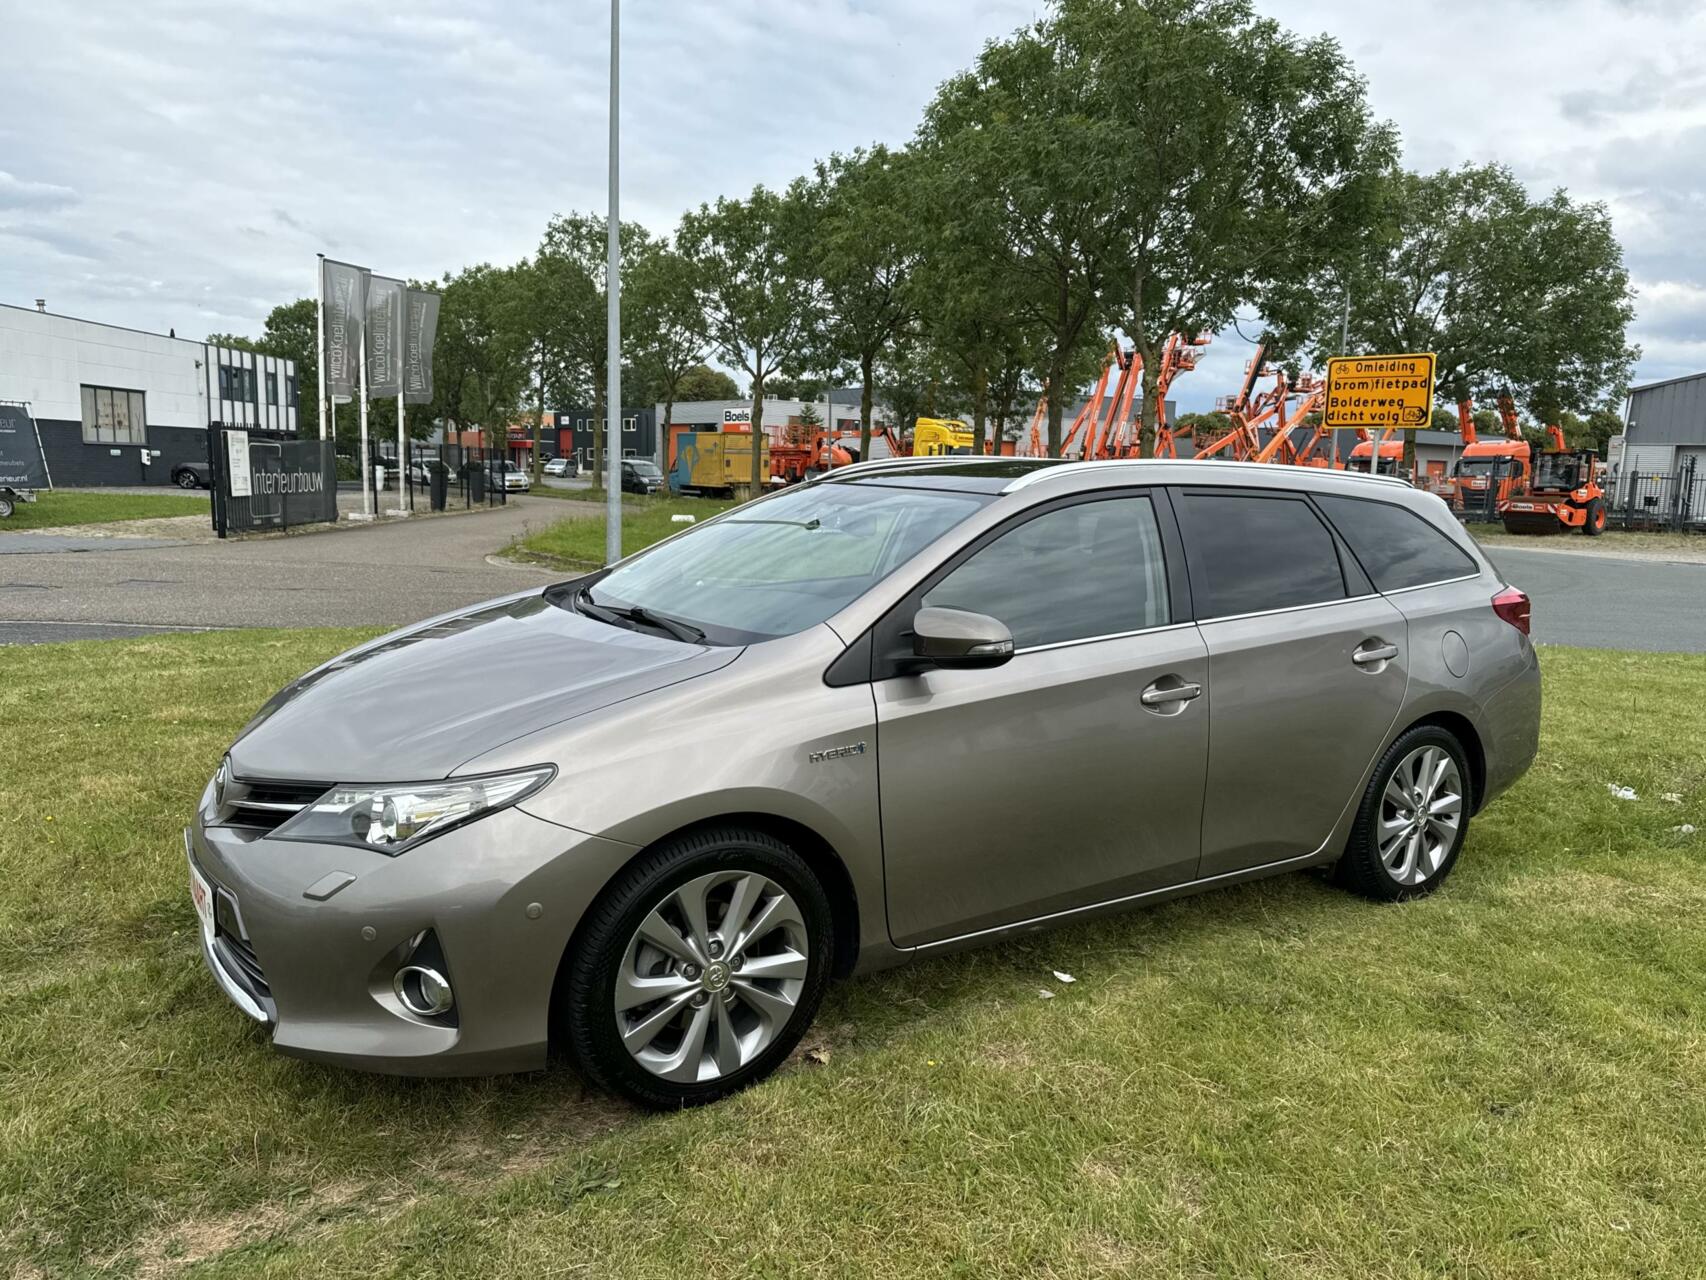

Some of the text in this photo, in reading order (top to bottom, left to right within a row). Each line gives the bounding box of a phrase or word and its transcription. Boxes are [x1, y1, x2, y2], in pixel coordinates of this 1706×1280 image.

[1356, 362, 1416, 374] Omleiding
[1329, 378, 1428, 392] (brom)fietpad
[1330, 397, 1404, 409] Bolderweg
[724, 410, 750, 422] Boels
[1327, 411, 1400, 424] dicht volg
[252, 466, 324, 495] Interieurbouw
[809, 745, 859, 763] HYBRID
